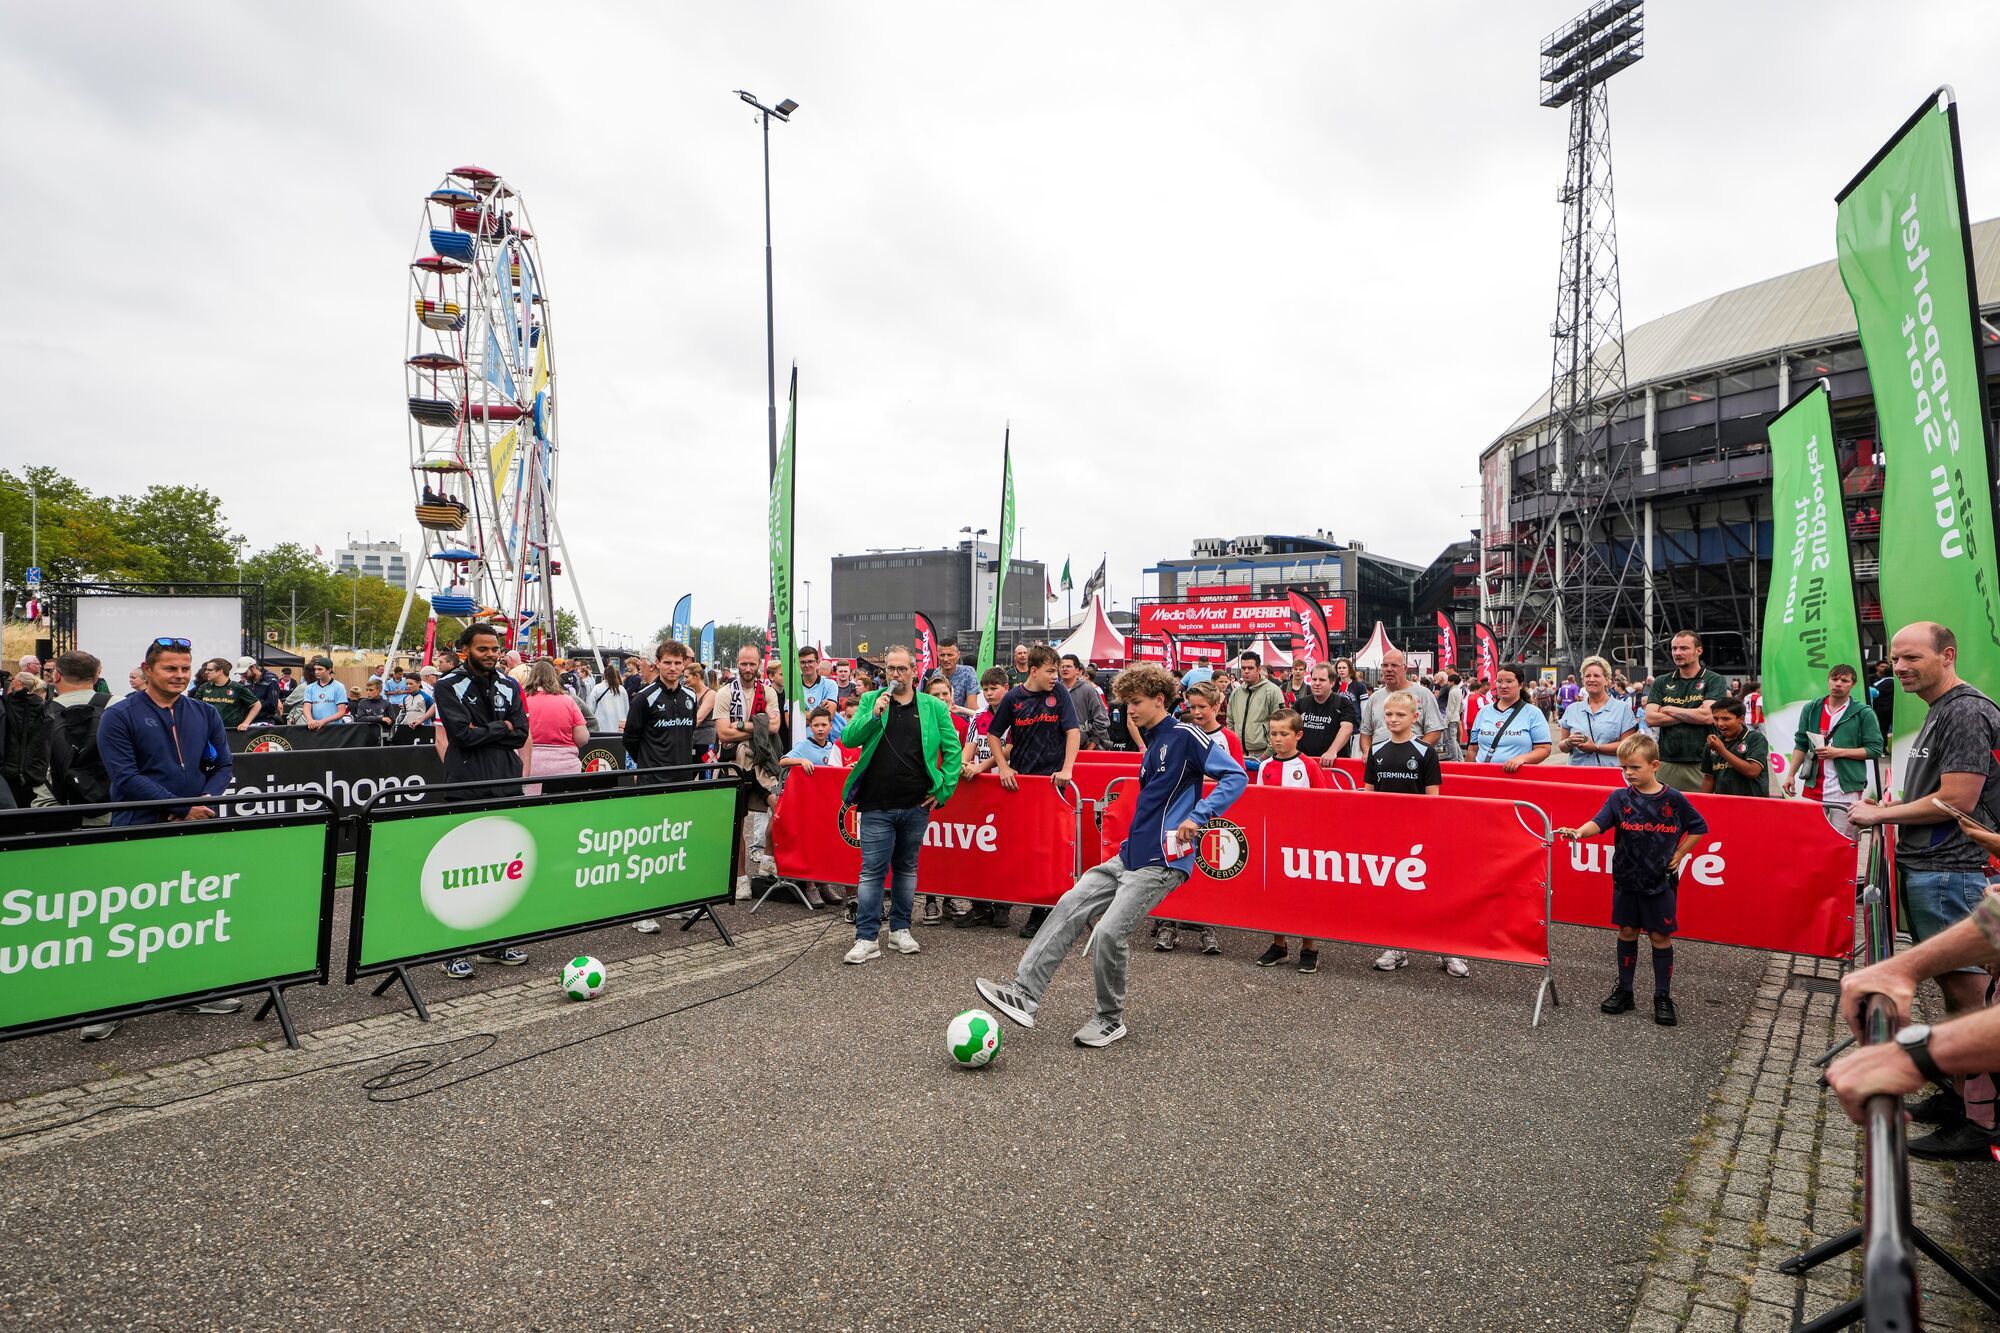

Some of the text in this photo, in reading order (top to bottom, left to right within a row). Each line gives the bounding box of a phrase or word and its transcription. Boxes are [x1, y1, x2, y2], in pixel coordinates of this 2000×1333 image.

[577, 817, 693, 857] Supporter
[922, 813, 998, 853] nivé
[442, 851, 524, 890] univé
[575, 847, 687, 888] van Sport
[1195, 855, 1245, 878] ROTTERDAM
[1280, 844, 1428, 892] univé
[0, 870, 240, 928] Supporter
[0, 909, 231, 974] van Sport
